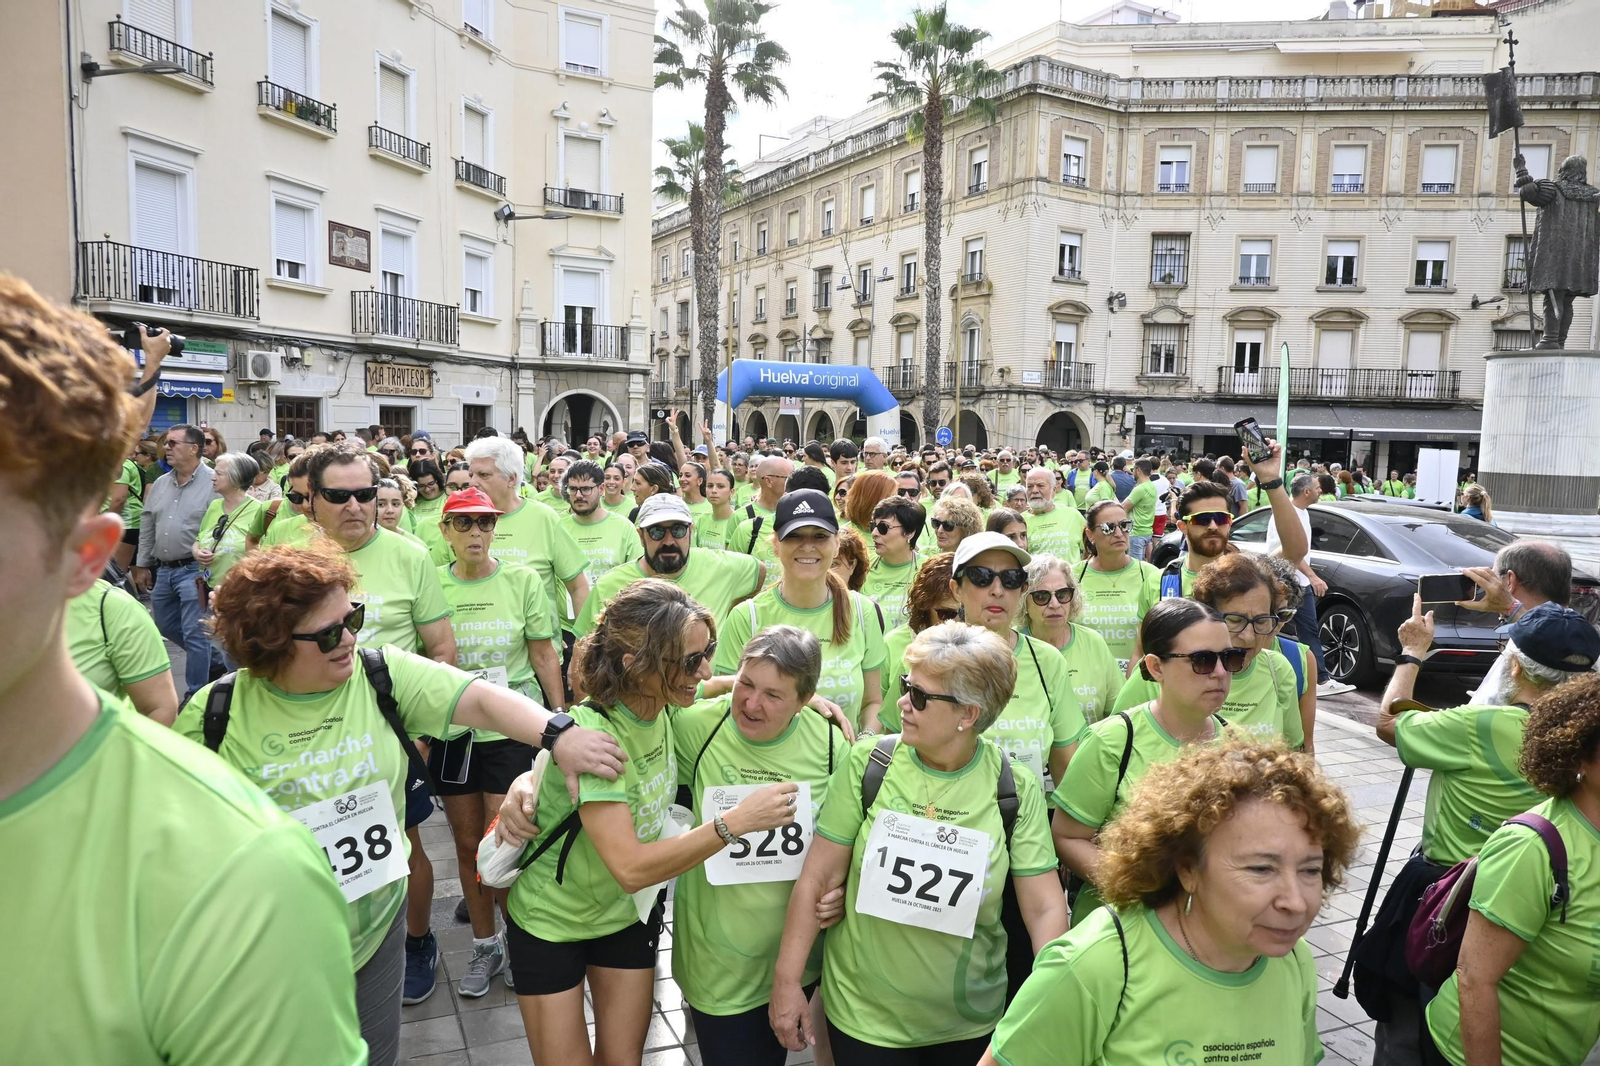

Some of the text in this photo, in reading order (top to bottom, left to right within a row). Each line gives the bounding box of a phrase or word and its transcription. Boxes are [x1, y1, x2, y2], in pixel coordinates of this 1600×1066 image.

[376, 366, 424, 388] LA TRAVIESA
[760, 368, 859, 389] Huelva original
[792, 507, 814, 515] adidas
[1100, 602, 1138, 612] march
[461, 618, 513, 631] marcha
[1082, 614, 1138, 625] contra e
[455, 632, 512, 648] ontra el
[457, 648, 510, 665] áncer
[1073, 684, 1098, 696] rcha
[289, 736, 312, 744] contra
[1029, 734, 1046, 751] el
[352, 752, 379, 778] el
[909, 837, 924, 845] CONTRA
[930, 842, 946, 850] CÁNCER
[345, 873, 362, 886] OCTUBRE
[877, 846, 974, 907] 1 527
[913, 902, 932, 911] OCTUBRE
[1203, 1038, 1275, 1052] asociación española
[1204, 1052, 1262, 1063] contra el cáncer
